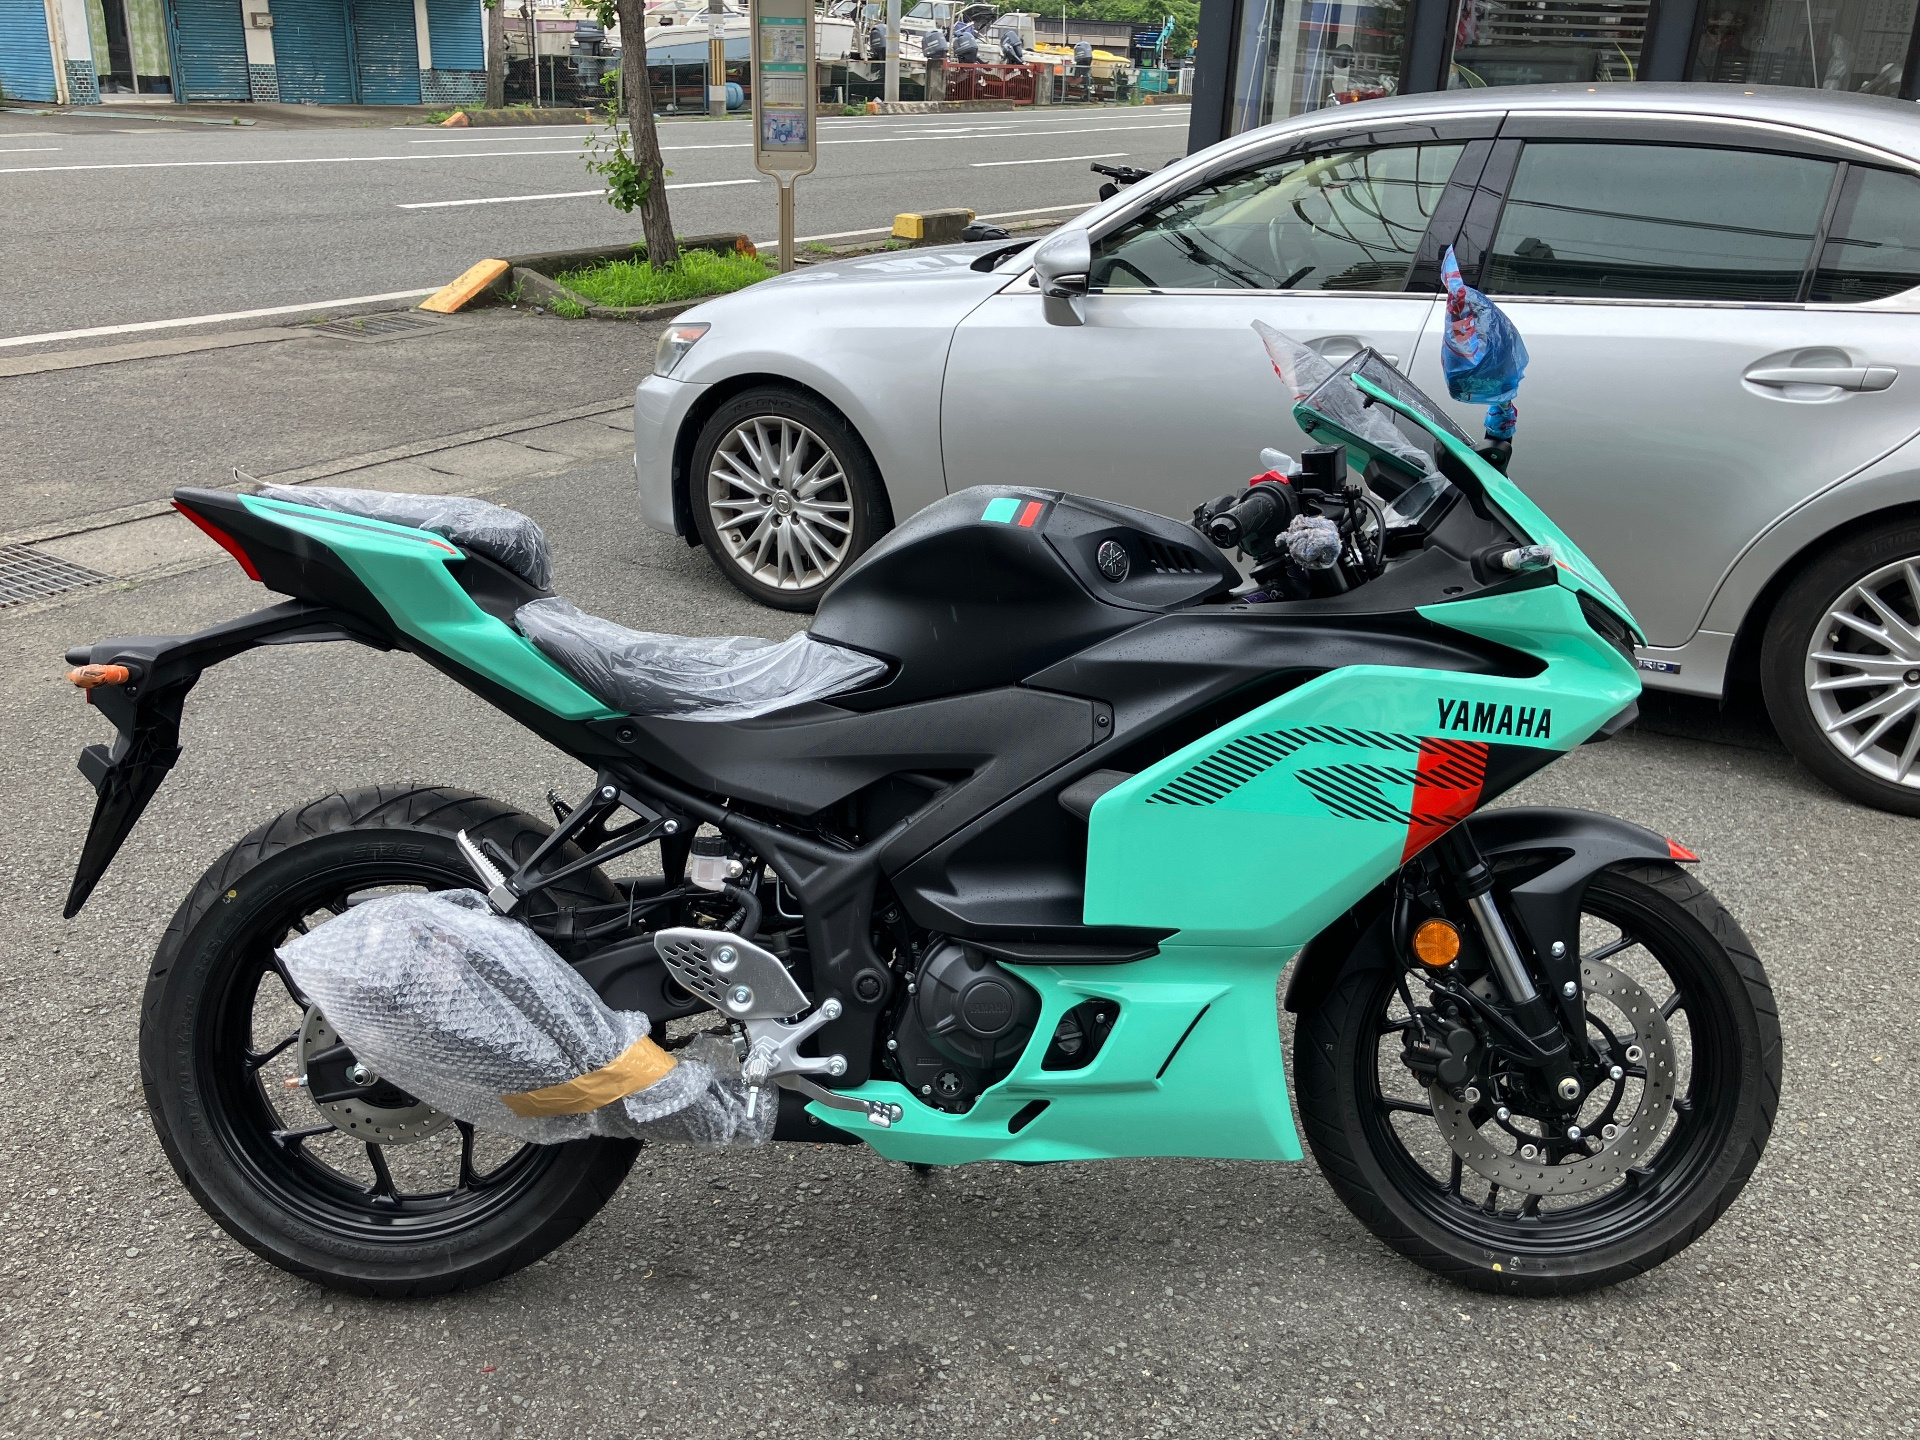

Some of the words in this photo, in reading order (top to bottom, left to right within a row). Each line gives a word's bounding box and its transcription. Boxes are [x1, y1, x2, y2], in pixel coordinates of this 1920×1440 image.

[733, 398, 792, 414] REGNO
[1437, 697, 1552, 739] YAMAHA
[968, 1002, 1009, 1014] YAMAHA
